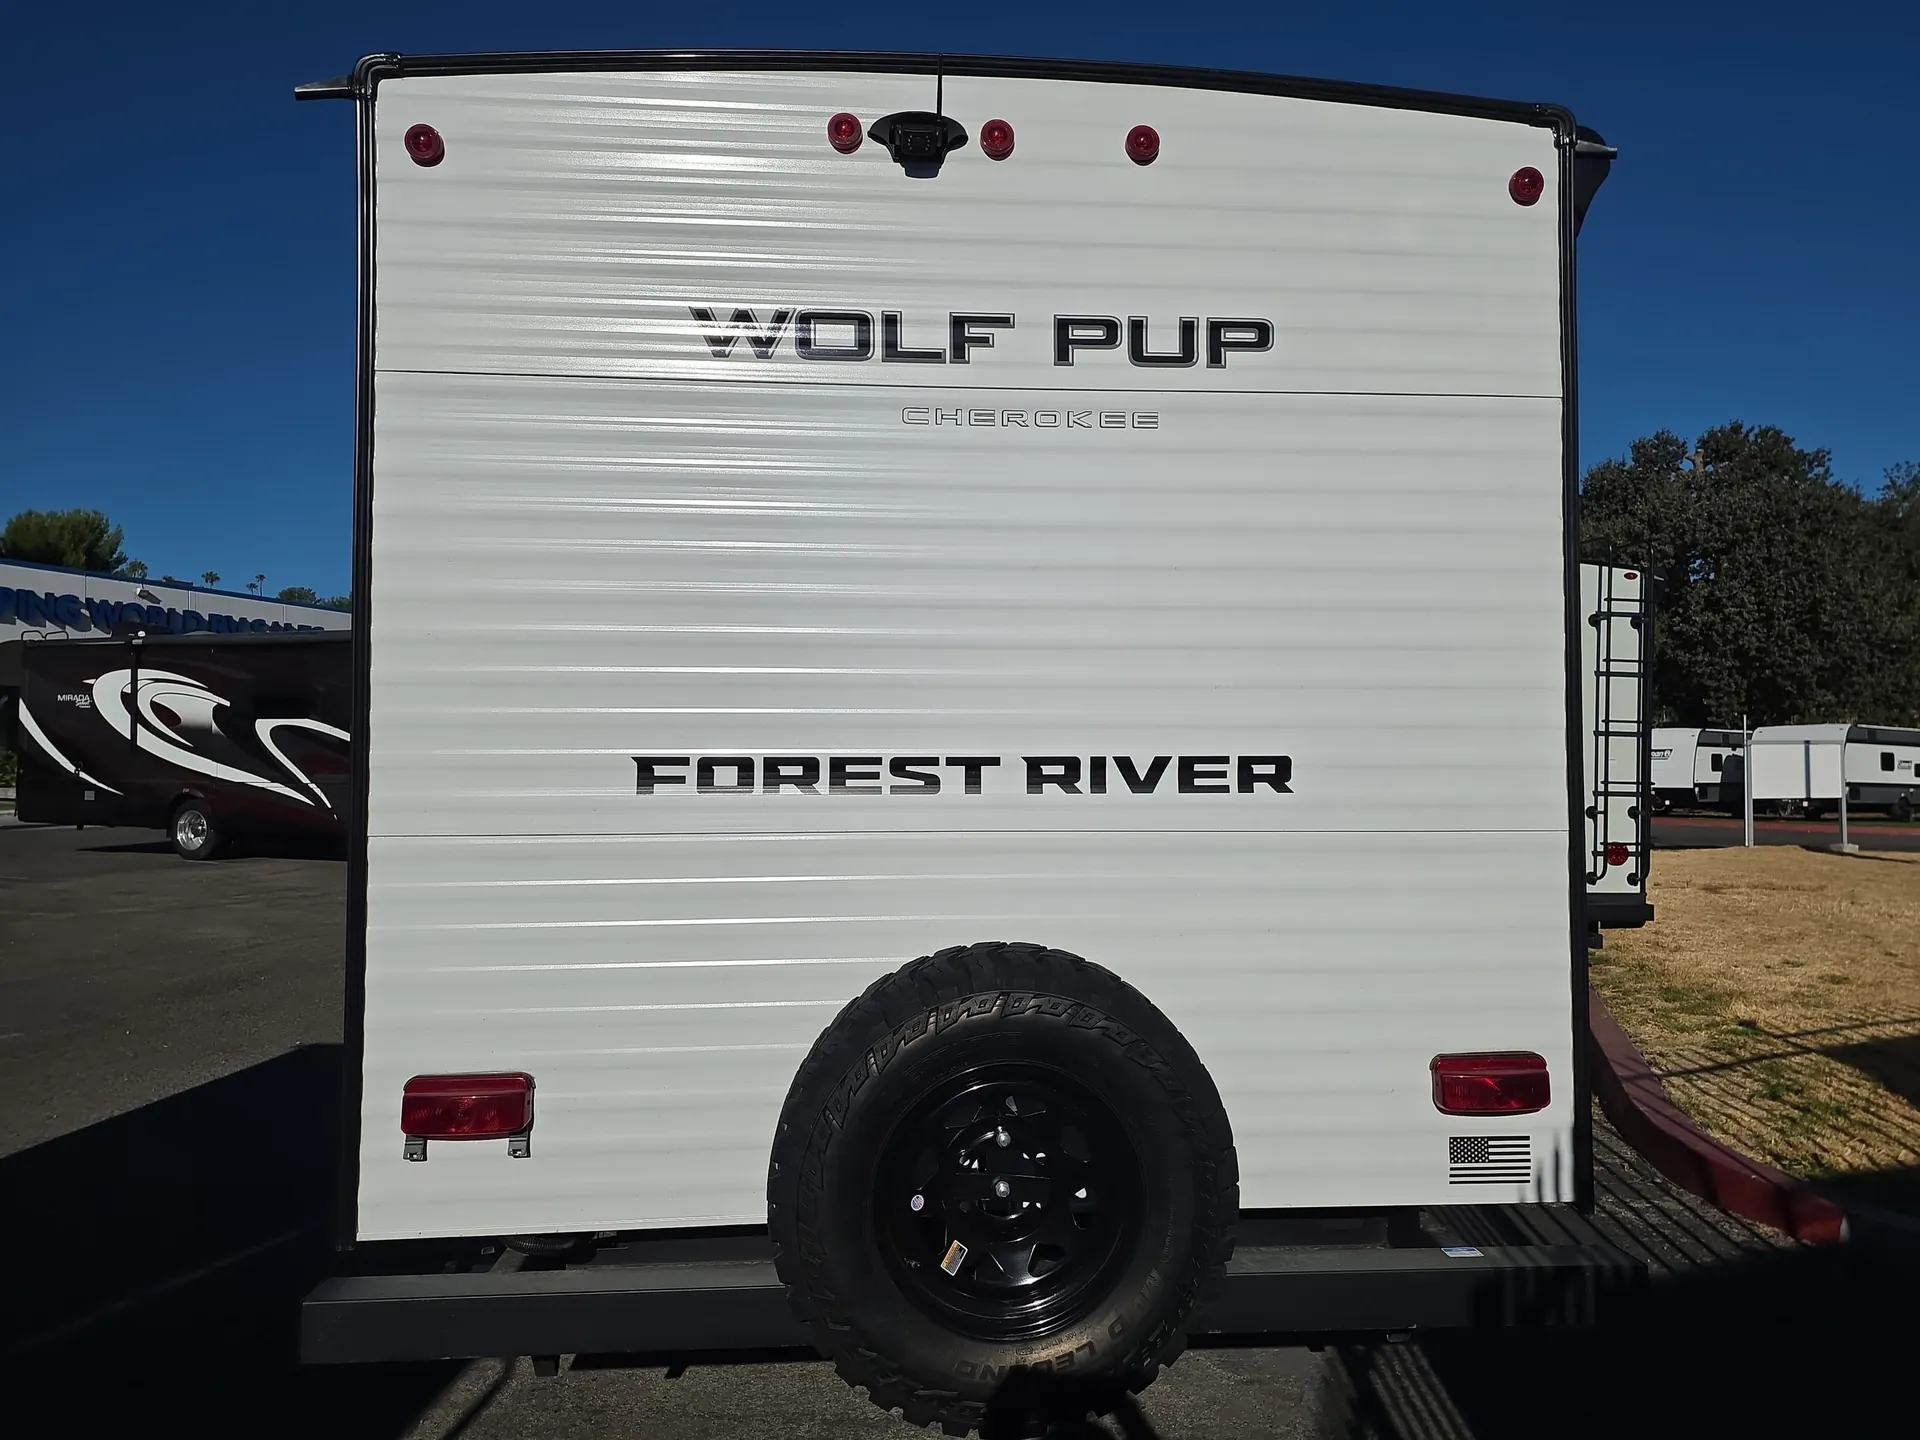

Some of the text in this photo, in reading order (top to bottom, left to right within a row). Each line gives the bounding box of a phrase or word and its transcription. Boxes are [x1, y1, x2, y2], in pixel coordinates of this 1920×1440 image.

[689, 307, 1274, 369] WOLF PUP
[901, 406, 1160, 430] CHEROKEE
[57, 694, 91, 702] MIRADA
[631, 755, 1295, 796] FOREST RIVER
